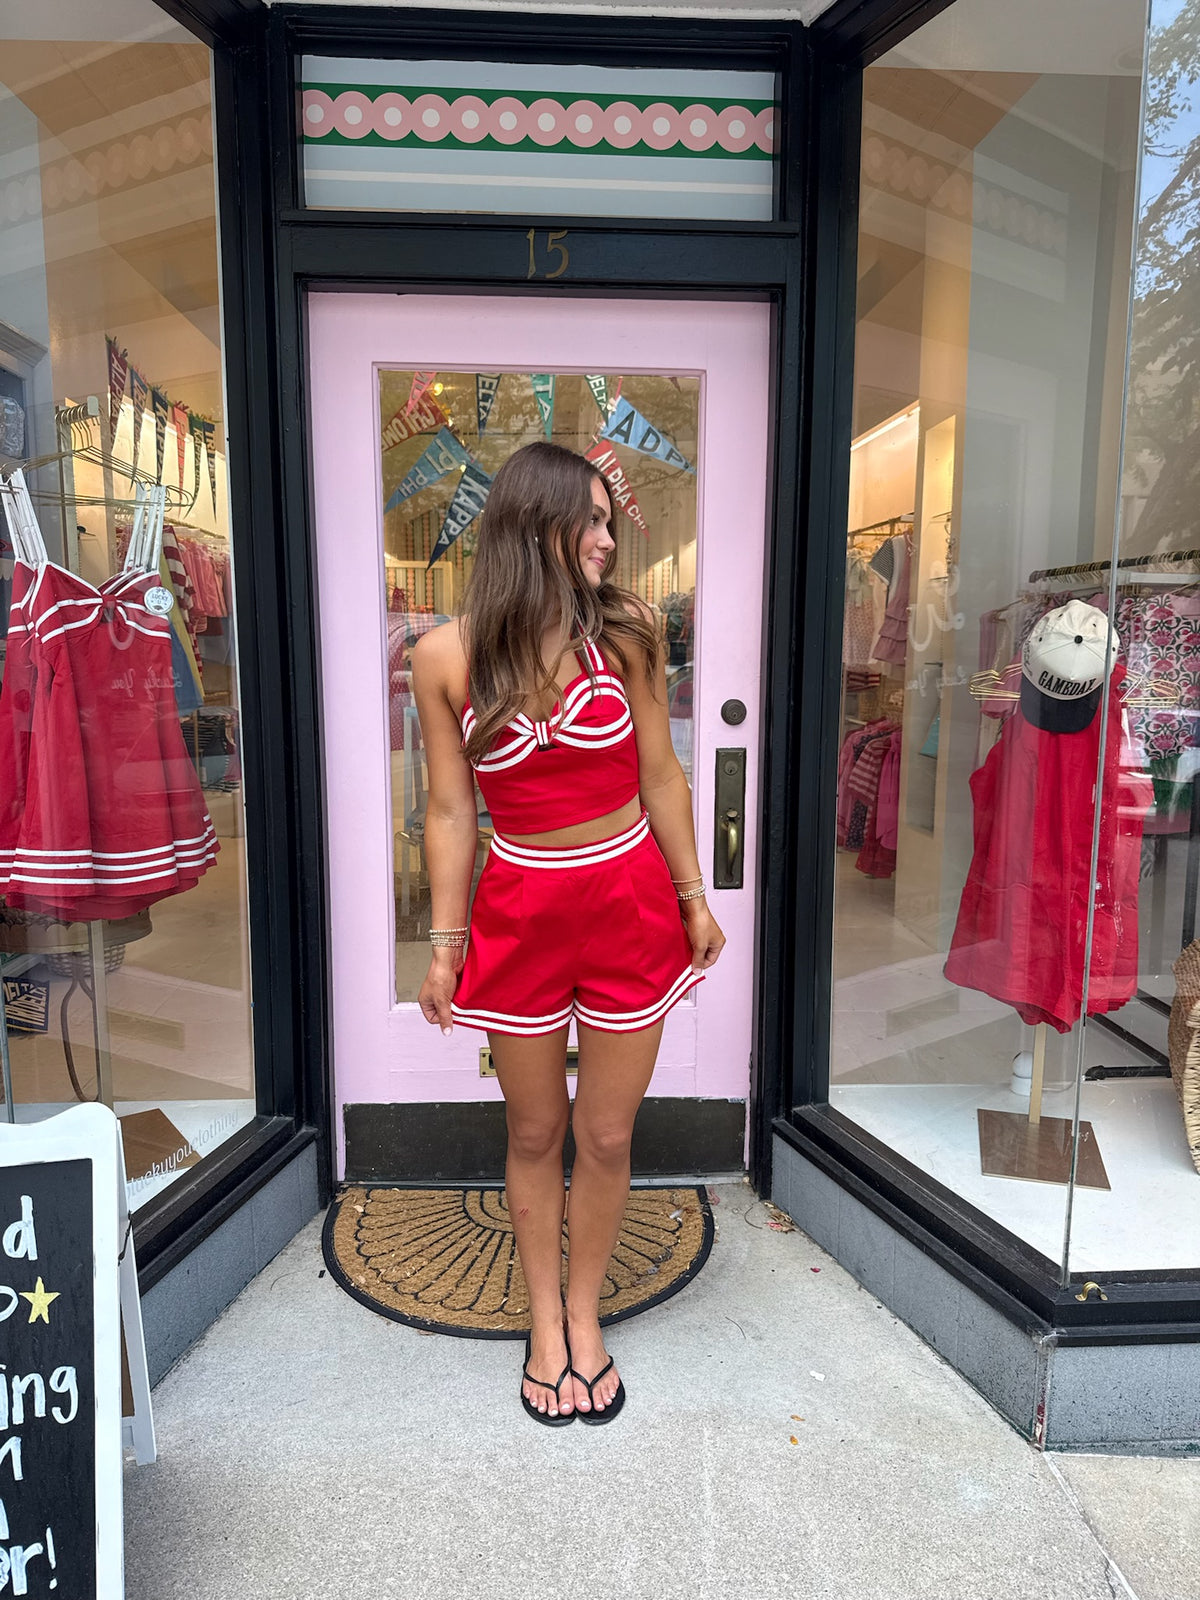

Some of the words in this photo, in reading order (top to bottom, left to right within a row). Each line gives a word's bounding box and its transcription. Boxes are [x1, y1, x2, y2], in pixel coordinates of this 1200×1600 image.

[526, 228, 569, 279] 15
[425, 438, 462, 475] PI
[399, 467, 428, 498] PHI
[591, 450, 632, 508] ALPHA
[438, 474, 490, 545] KAPPA
[1038, 670, 1097, 696] GAMEDAY
